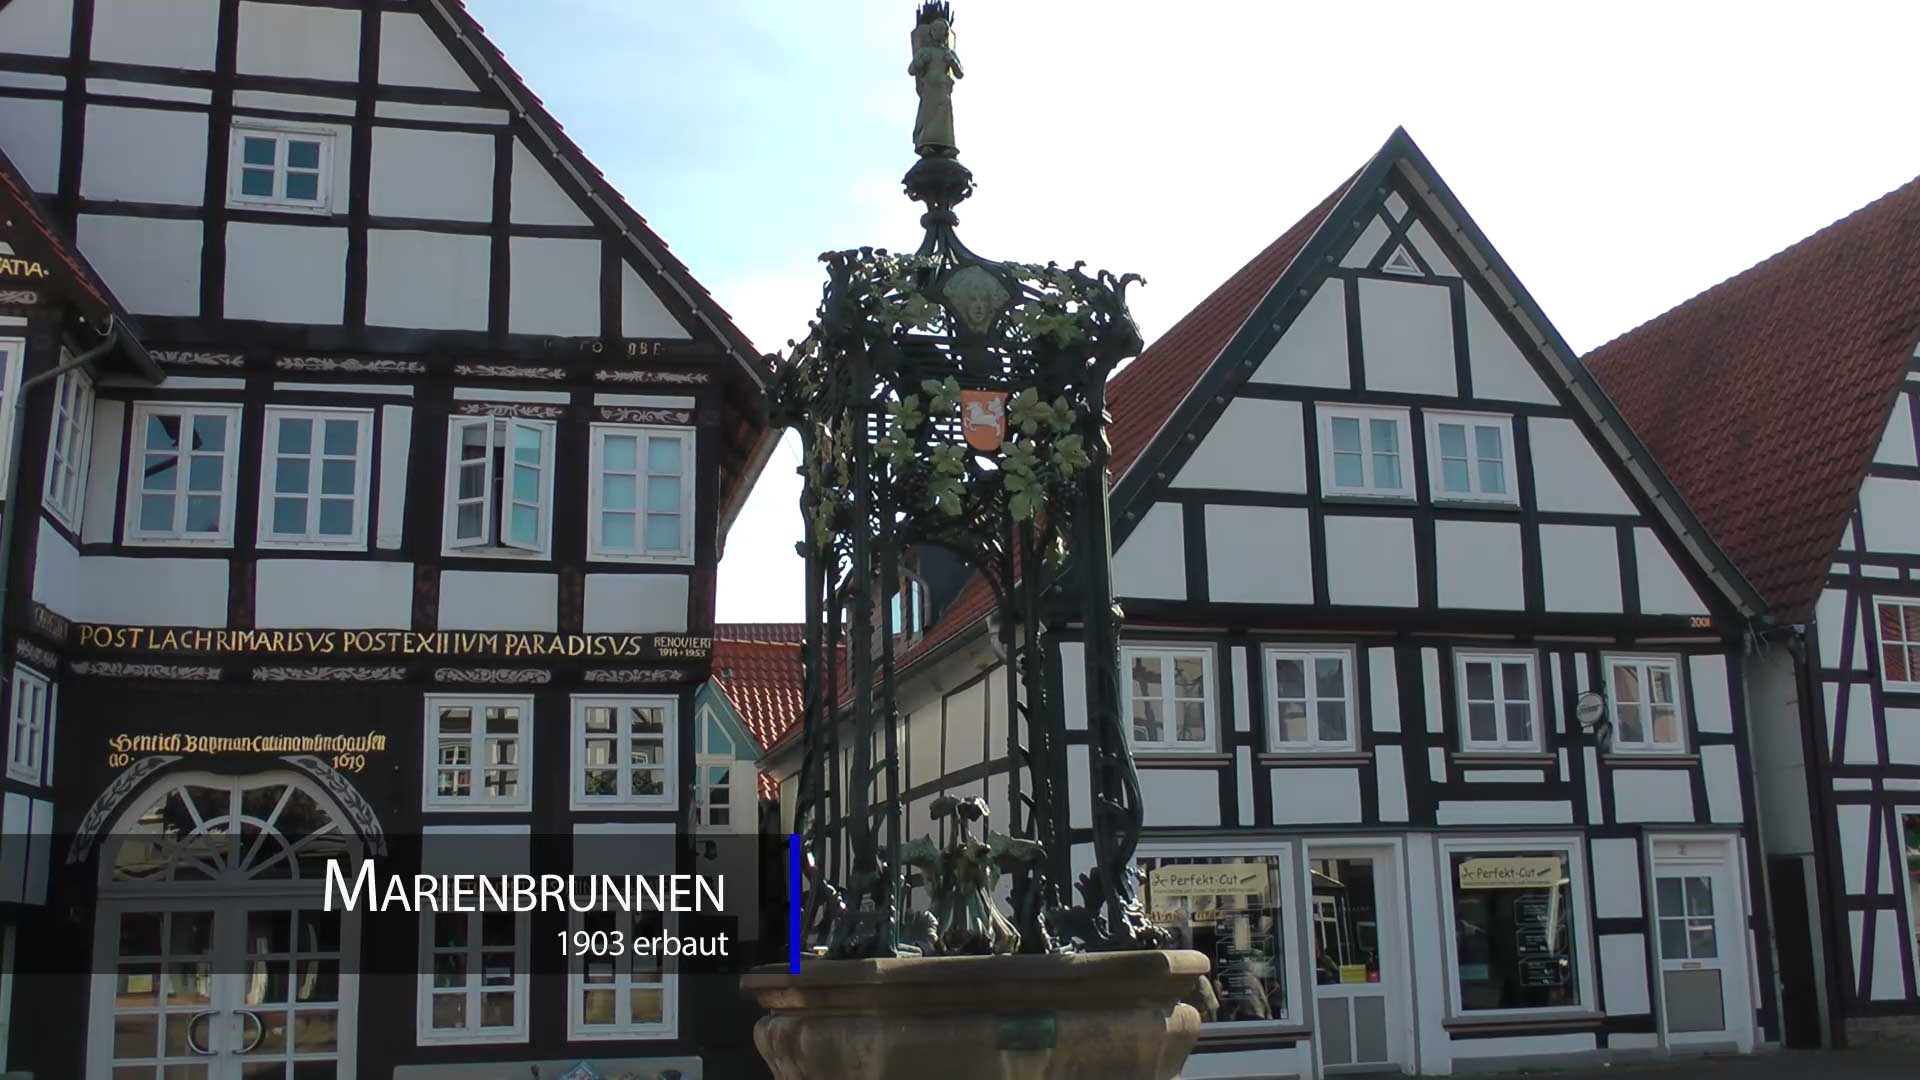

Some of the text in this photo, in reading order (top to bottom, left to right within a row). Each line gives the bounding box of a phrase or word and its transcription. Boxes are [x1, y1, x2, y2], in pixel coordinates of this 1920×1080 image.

[80, 624, 144, 649] POST
[343, 630, 402, 653] POST
[504, 633, 642, 656] PARADISVS
[654, 636, 712, 649] RENOVIERT
